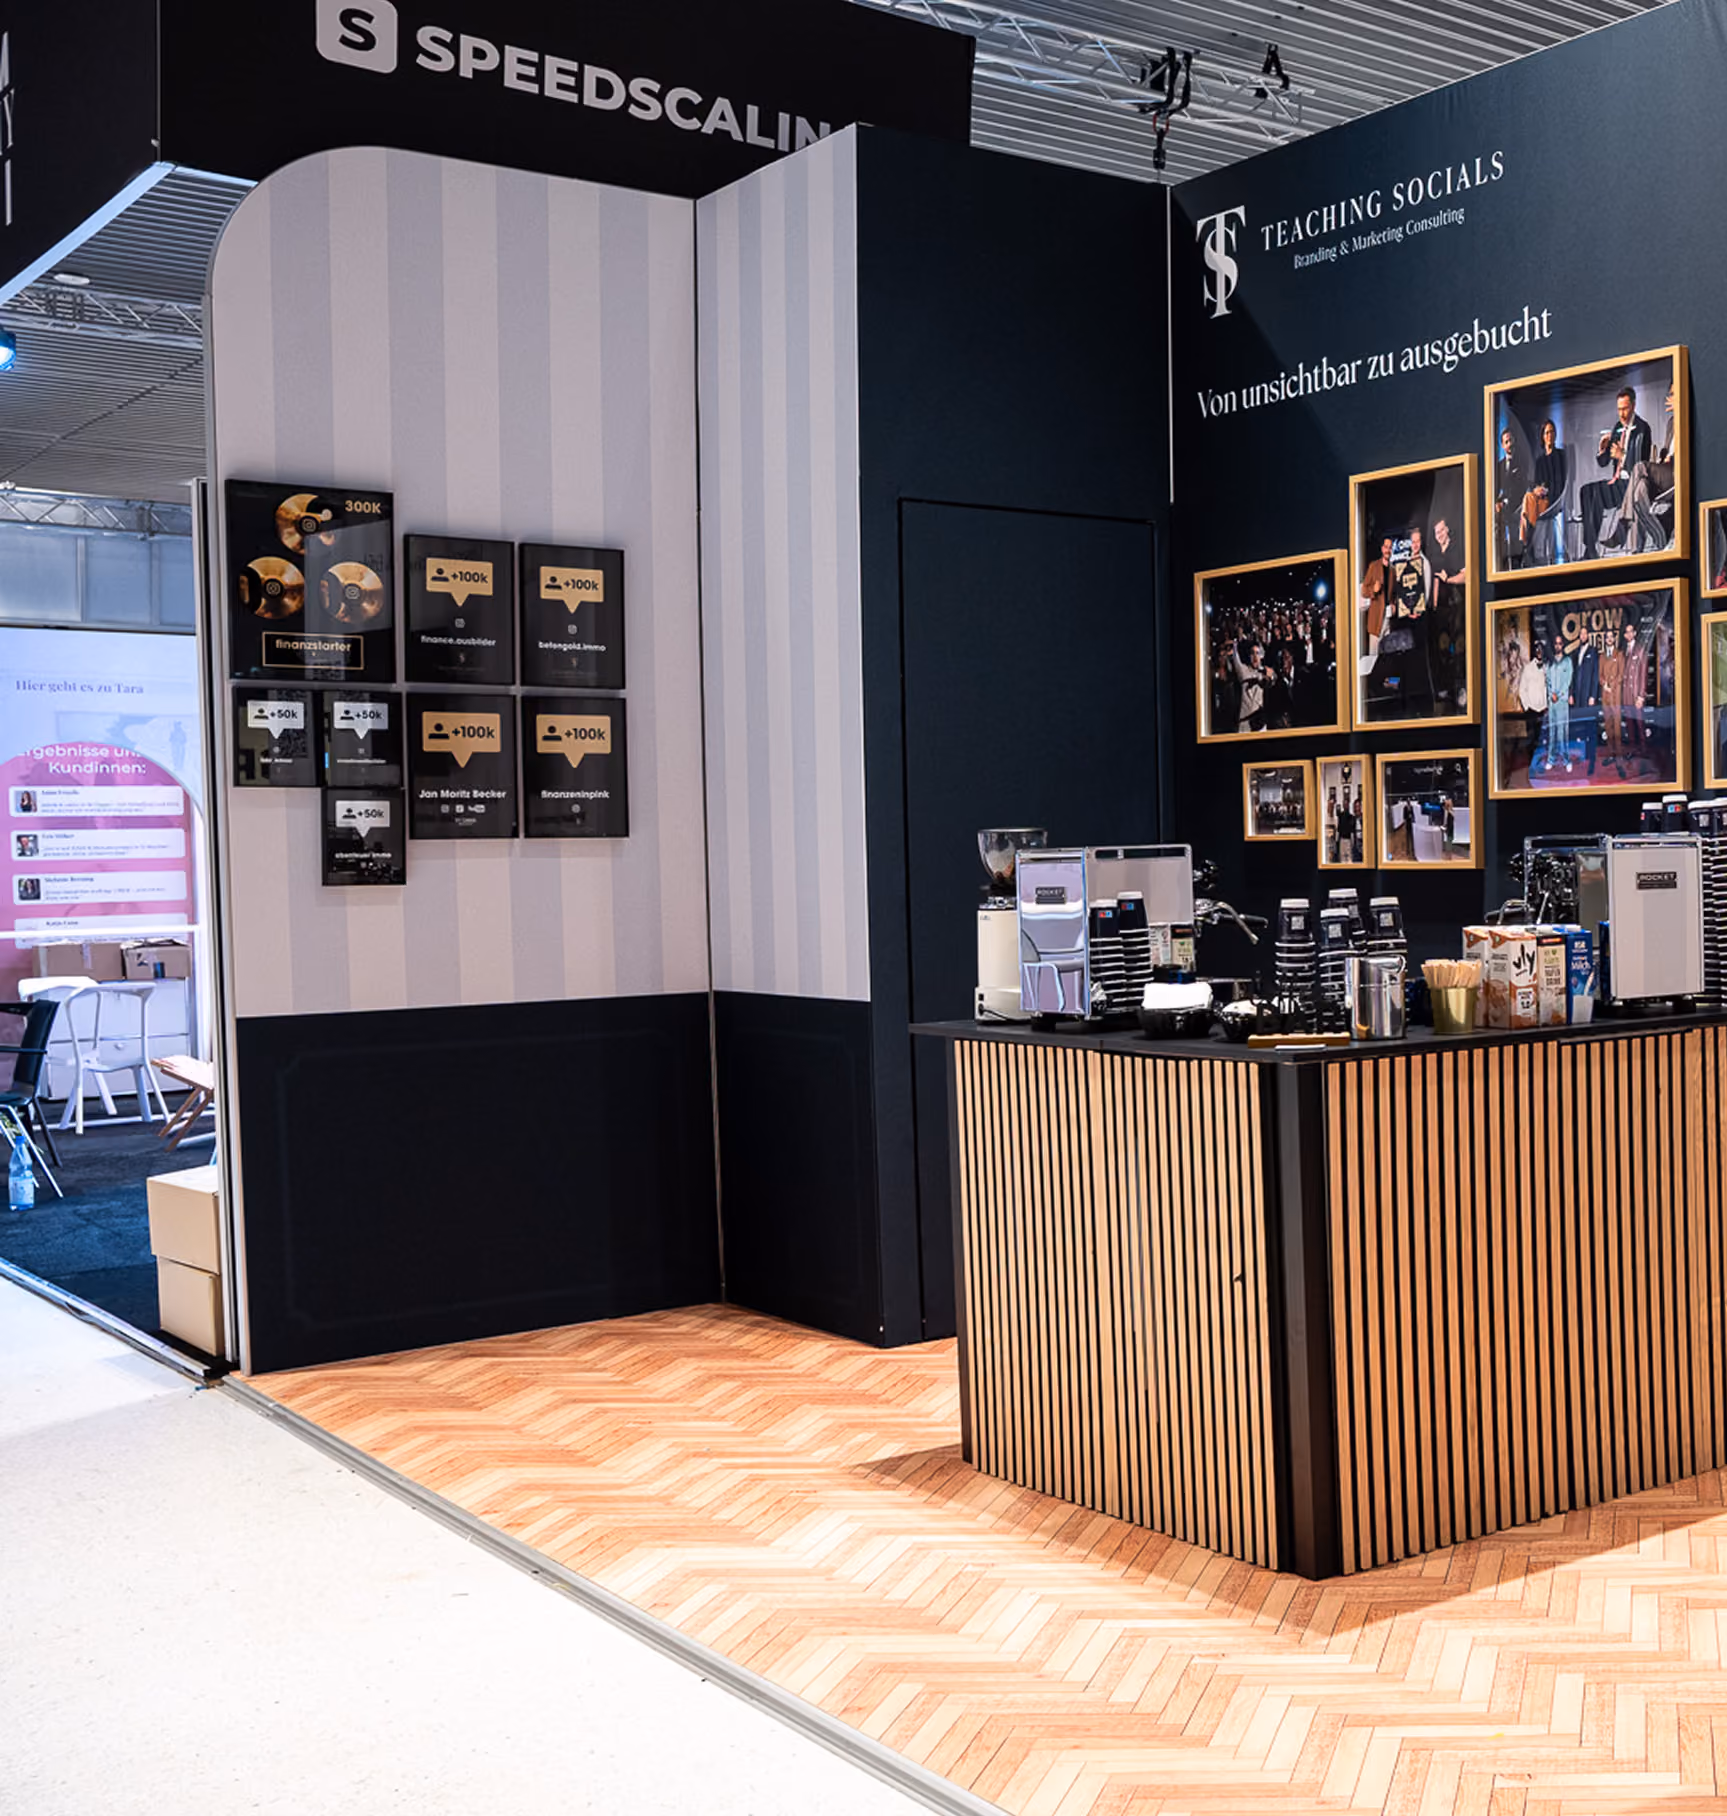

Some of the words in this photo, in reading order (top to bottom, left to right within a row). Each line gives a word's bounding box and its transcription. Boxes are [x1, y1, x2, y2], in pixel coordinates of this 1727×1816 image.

[1261, 189, 1382, 251] TEACHING
[1392, 150, 1505, 212] SOCIALS
[1293, 244, 1337, 270] Branding
[1339, 241, 1350, 255] &
[1352, 225, 1404, 253] Marketing
[1406, 207, 1465, 236] Consulting
[1197, 389, 1238, 419] Von
[1242, 357, 1362, 410] unsichtbar
[1367, 352, 1395, 381] zu
[1400, 305, 1553, 373] ausgebucht
[345, 500, 382, 514] 300K
[275, 639, 352, 652] finanzstarter
[16, 680, 48, 692] Hier
[49, 681, 77, 694] geht
[80, 683, 94, 693] es
[97, 683, 112, 693] zu
[115, 683, 144, 694] Tara
[452, 725, 495, 739] +100k
[564, 728, 606, 741] +100k
[18, 745, 110, 760] rgebnisse
[49, 761, 147, 775] Kundinnen:
[419, 789, 438, 799] Jan
[440, 789, 471, 799] Moritz
[472, 789, 507, 799] Becker
[1639, 872, 1676, 881] ROCKET
